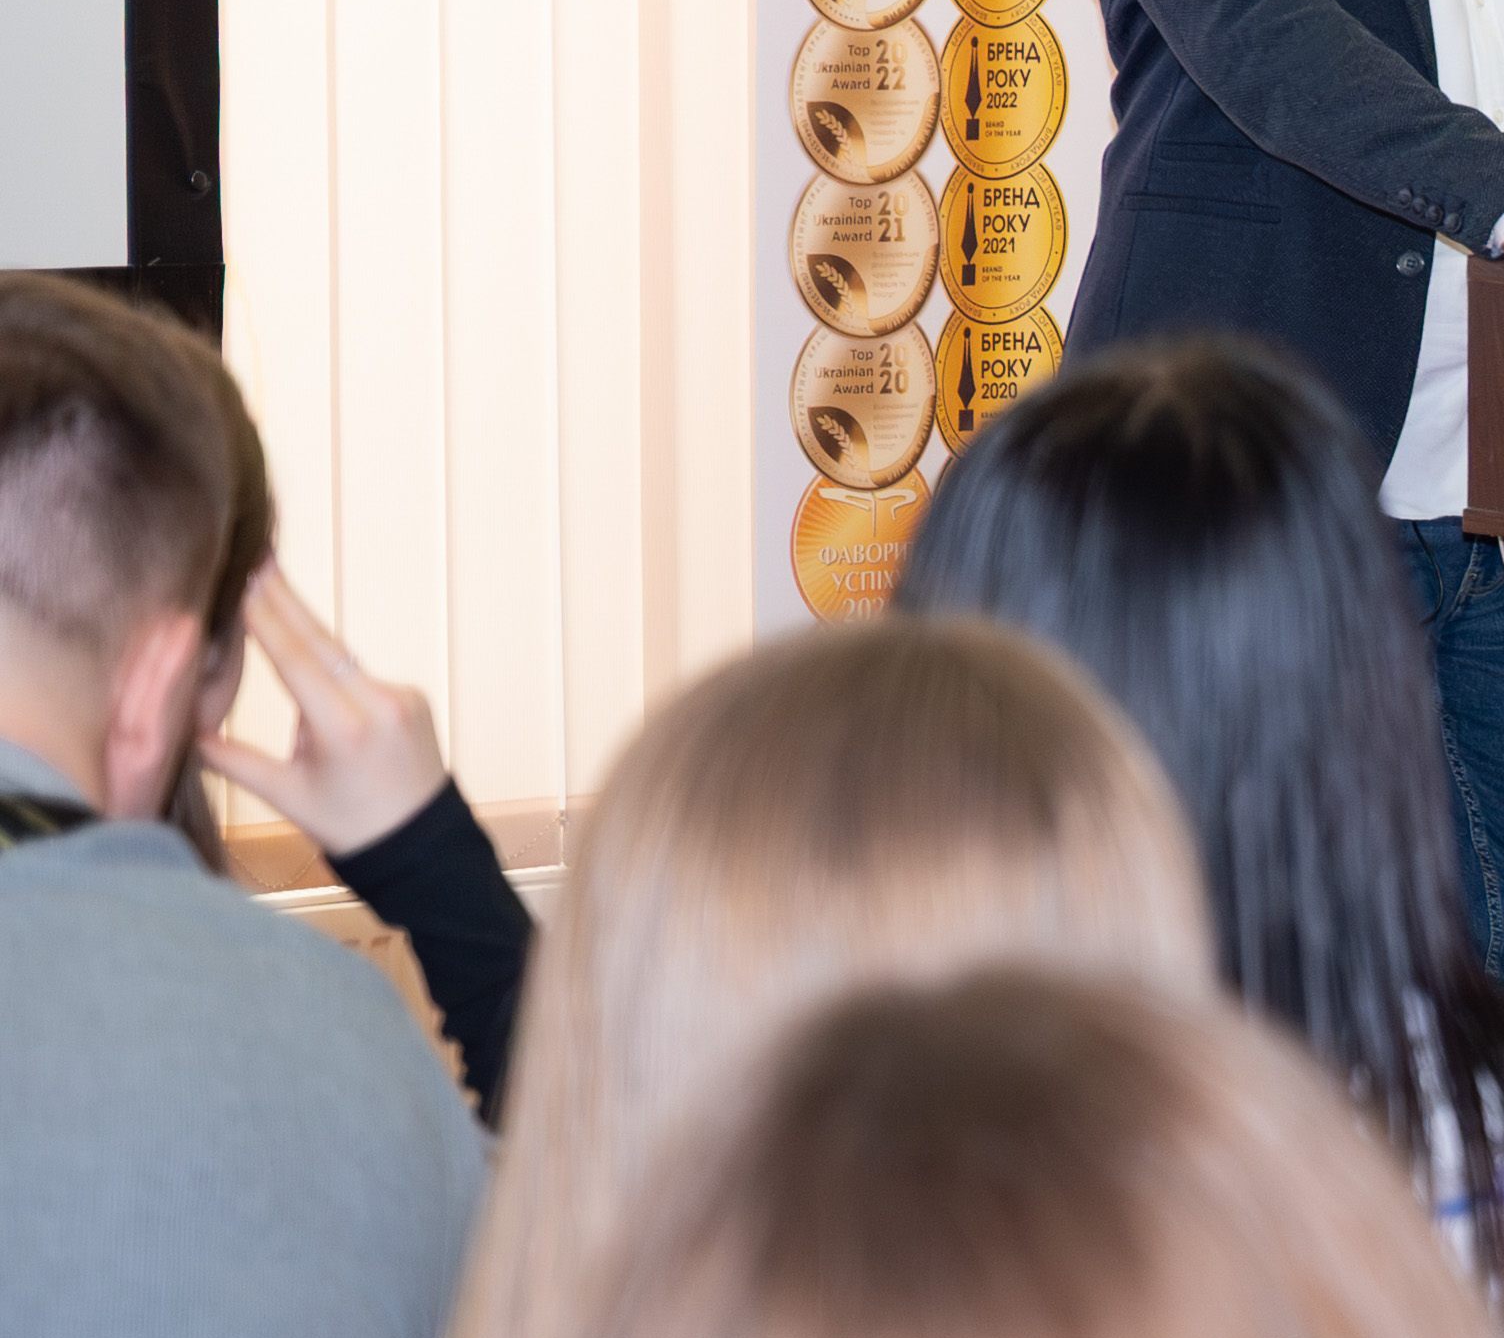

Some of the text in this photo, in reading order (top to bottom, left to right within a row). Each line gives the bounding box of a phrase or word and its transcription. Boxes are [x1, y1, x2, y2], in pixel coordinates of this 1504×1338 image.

[847, 45, 870, 57] Top
[987, 42, 1041, 64] БРЕНД
[831, 78, 870, 90] Award
[986, 69, 1031, 88] РОКУ
[986, 91, 1018, 109] 2022
[848, 197, 872, 210] Top
[983, 187, 1040, 209] БРЕНД
[983, 214, 1031, 234] РОКУ
[832, 230, 873, 243] Award
[983, 237, 1015, 254] 2021
[981, 331, 1042, 353] БРЕНД
[850, 349, 873, 361] Top
[981, 358, 1032, 379] РОКУ
[833, 382, 874, 394] Award
[981, 382, 1018, 399] 2020
[831, 570, 899, 593] УСПІХ
